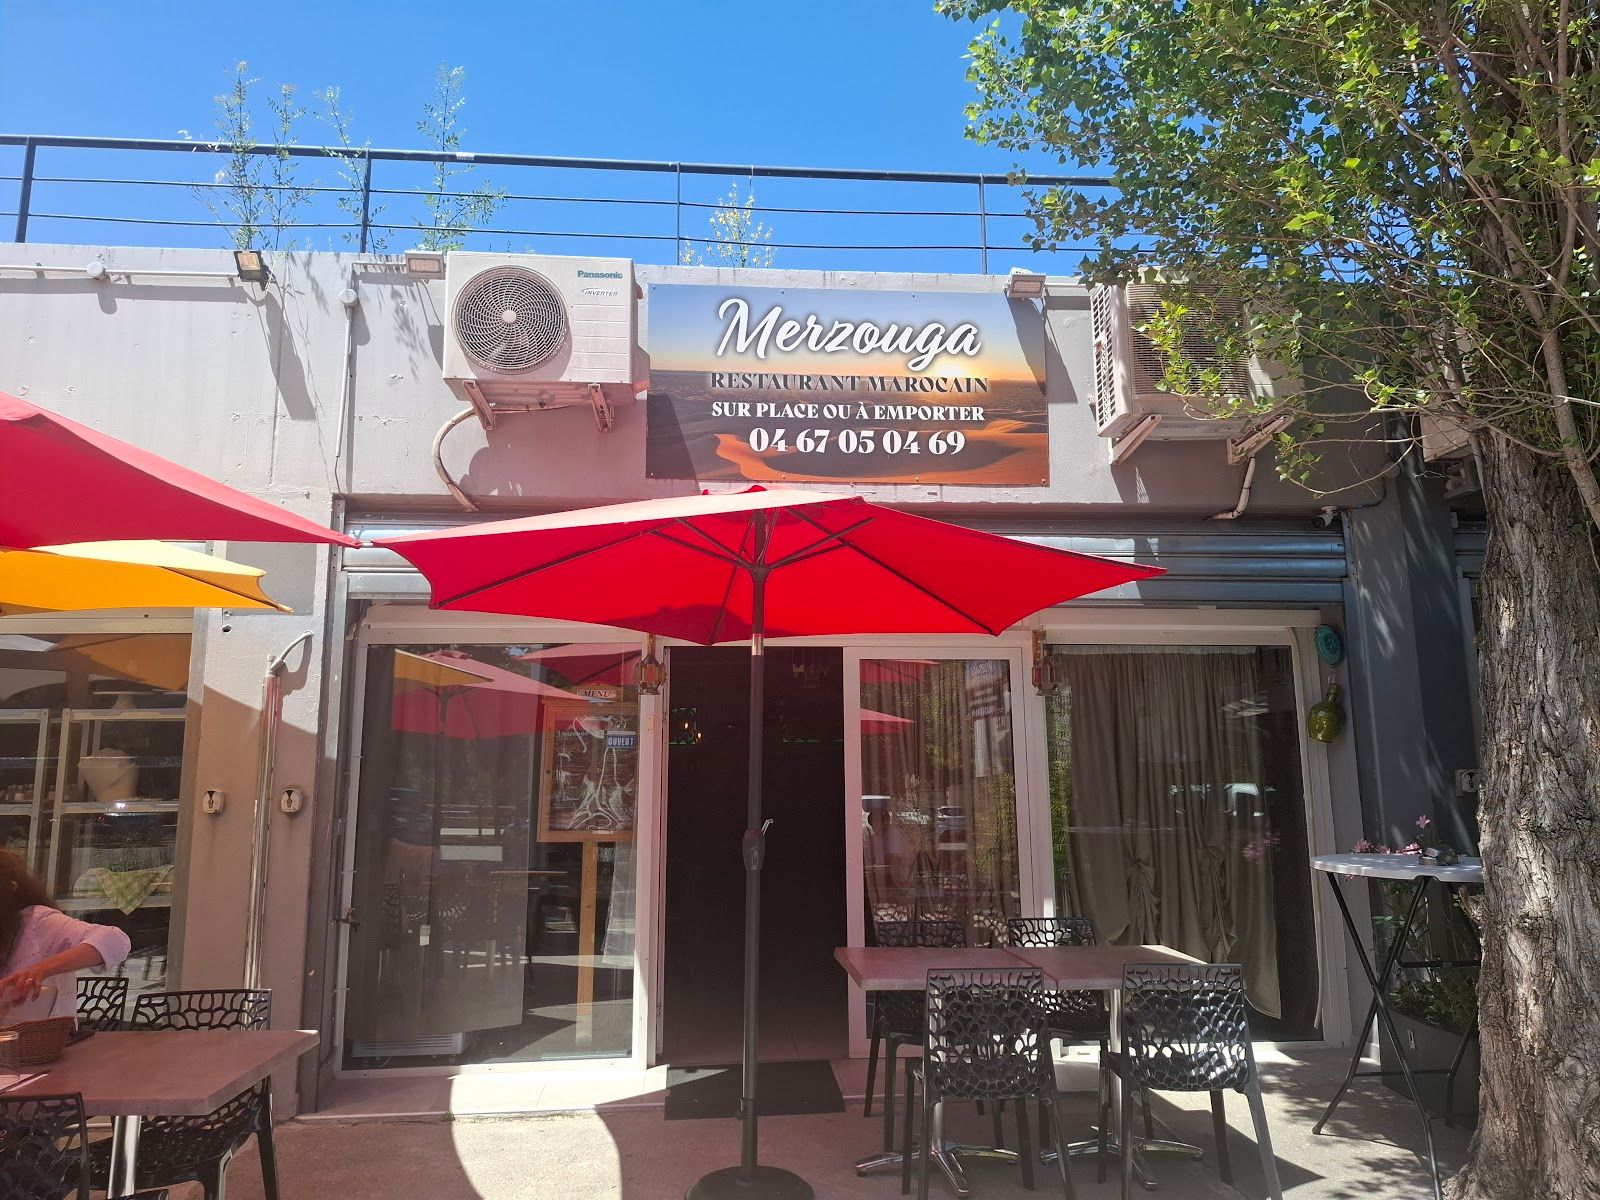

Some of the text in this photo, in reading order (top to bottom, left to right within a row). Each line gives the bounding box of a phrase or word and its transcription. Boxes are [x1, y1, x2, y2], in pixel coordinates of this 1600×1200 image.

[577, 270, 624, 279] Panasonic
[716, 298, 982, 372] Merzouga
[711, 372, 988, 393] RESTAURANT MAROCAIN
[711, 401, 986, 421] SUR PLACE OU À EMPORTER
[749, 427, 966, 455] 04 67 05 04 69
[583, 690, 611, 698] MENU
[607, 736, 635, 747] OUVERT
